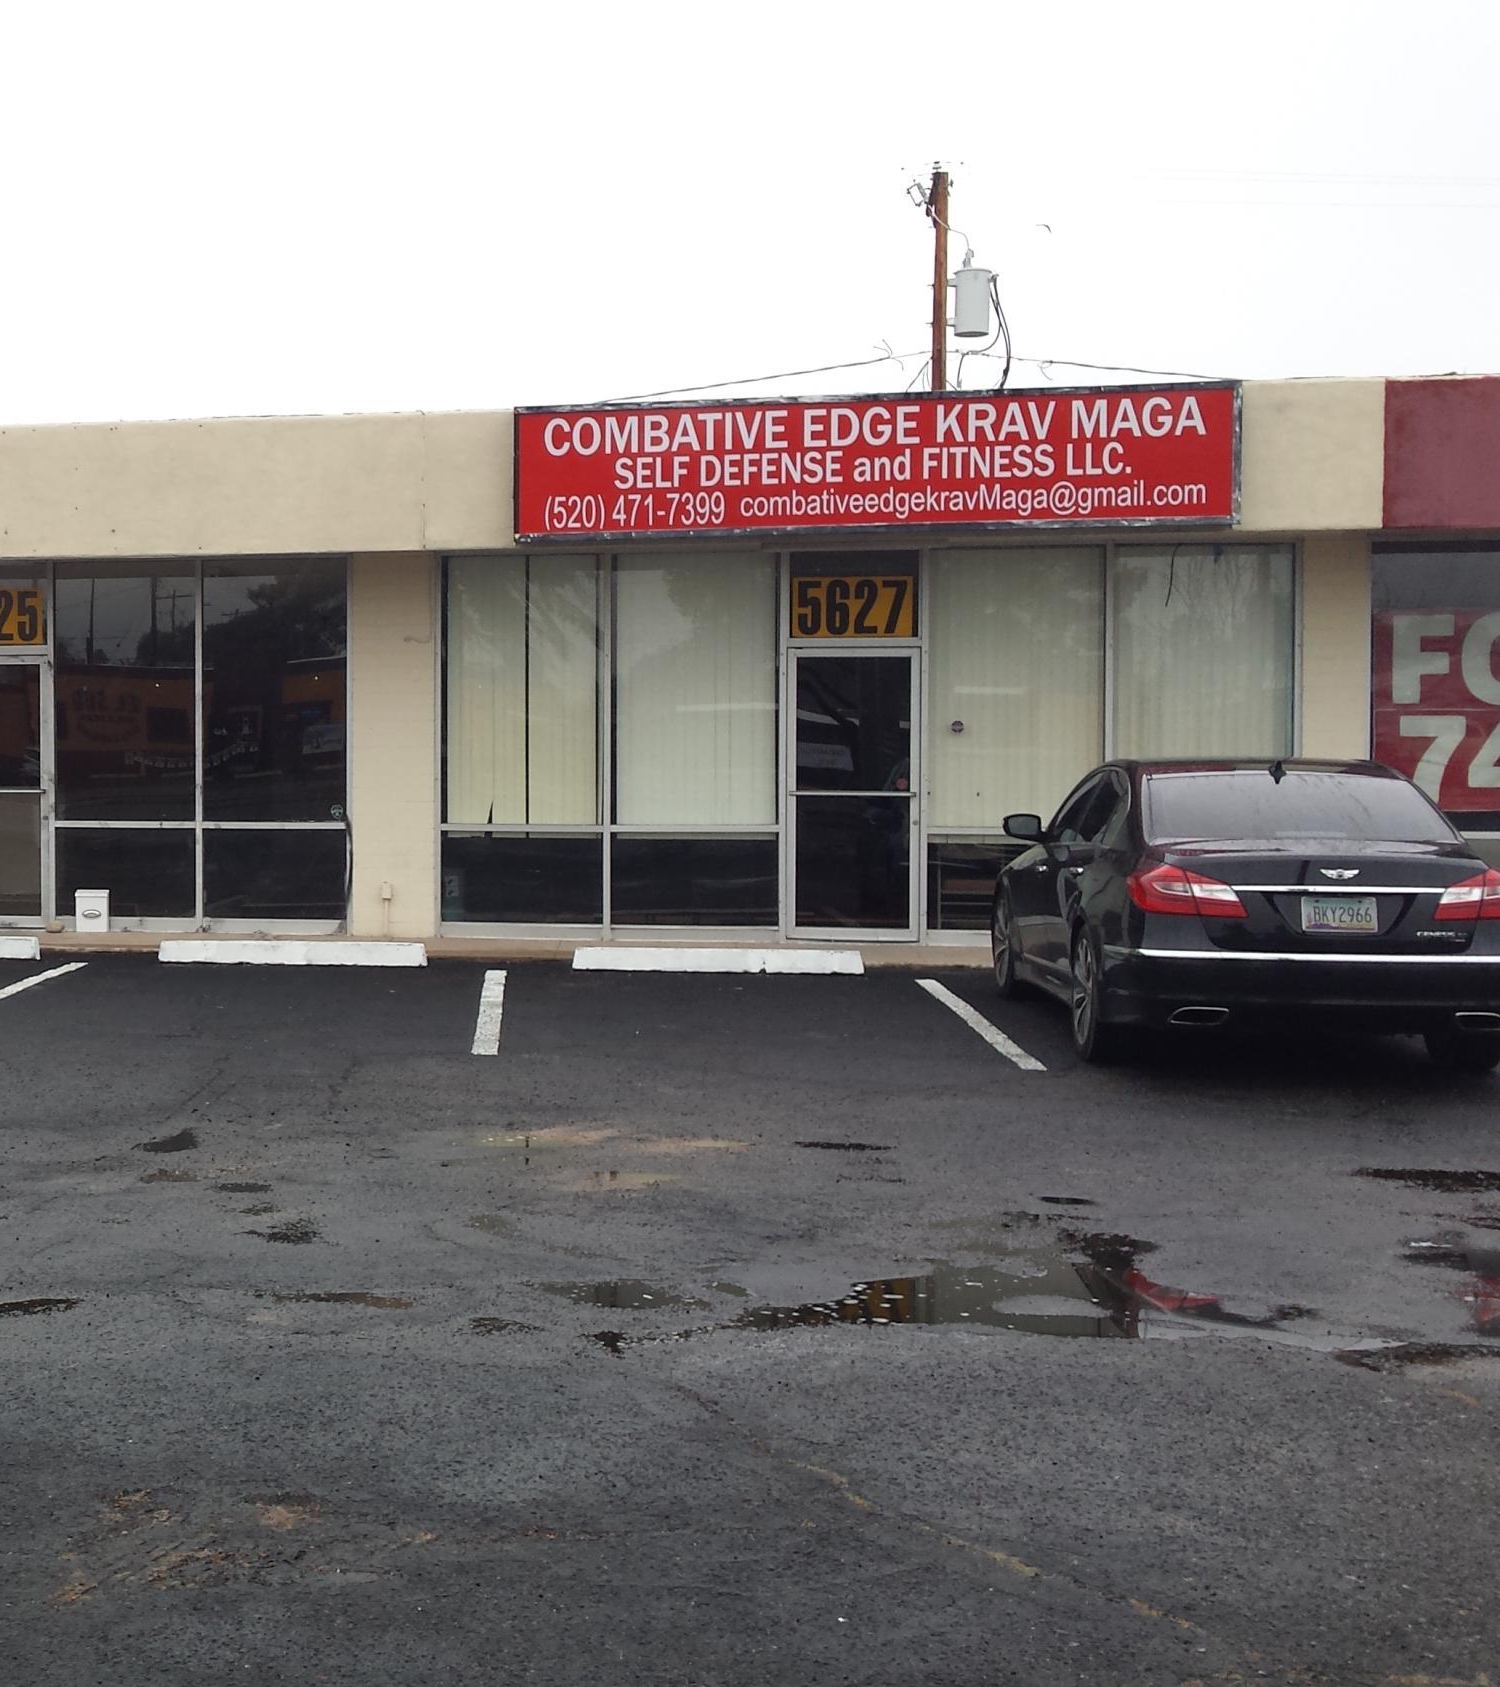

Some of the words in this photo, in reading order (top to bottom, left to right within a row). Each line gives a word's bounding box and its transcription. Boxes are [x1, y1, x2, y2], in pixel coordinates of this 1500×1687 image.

[544, 410, 789, 457] COMBATIVE
[803, 405, 921, 449] EDGE
[935, 400, 1056, 443] KRAV
[1071, 395, 1207, 439] MAGA
[614, 456, 690, 489] SELF
[700, 451, 844, 487] DEFENSE
[853, 449, 911, 482] and
[922, 443, 1055, 480] FITNESS
[1066, 442, 1132, 476] LLC.
[544, 494, 605, 530] (520)
[612, 490, 725, 528] 471-7399
[740, 480, 1207, 519] combativeedgekravMaga@gmail.com
[798, 579, 907, 635] 5627
[1313, 906, 1373, 924] BKY2966
